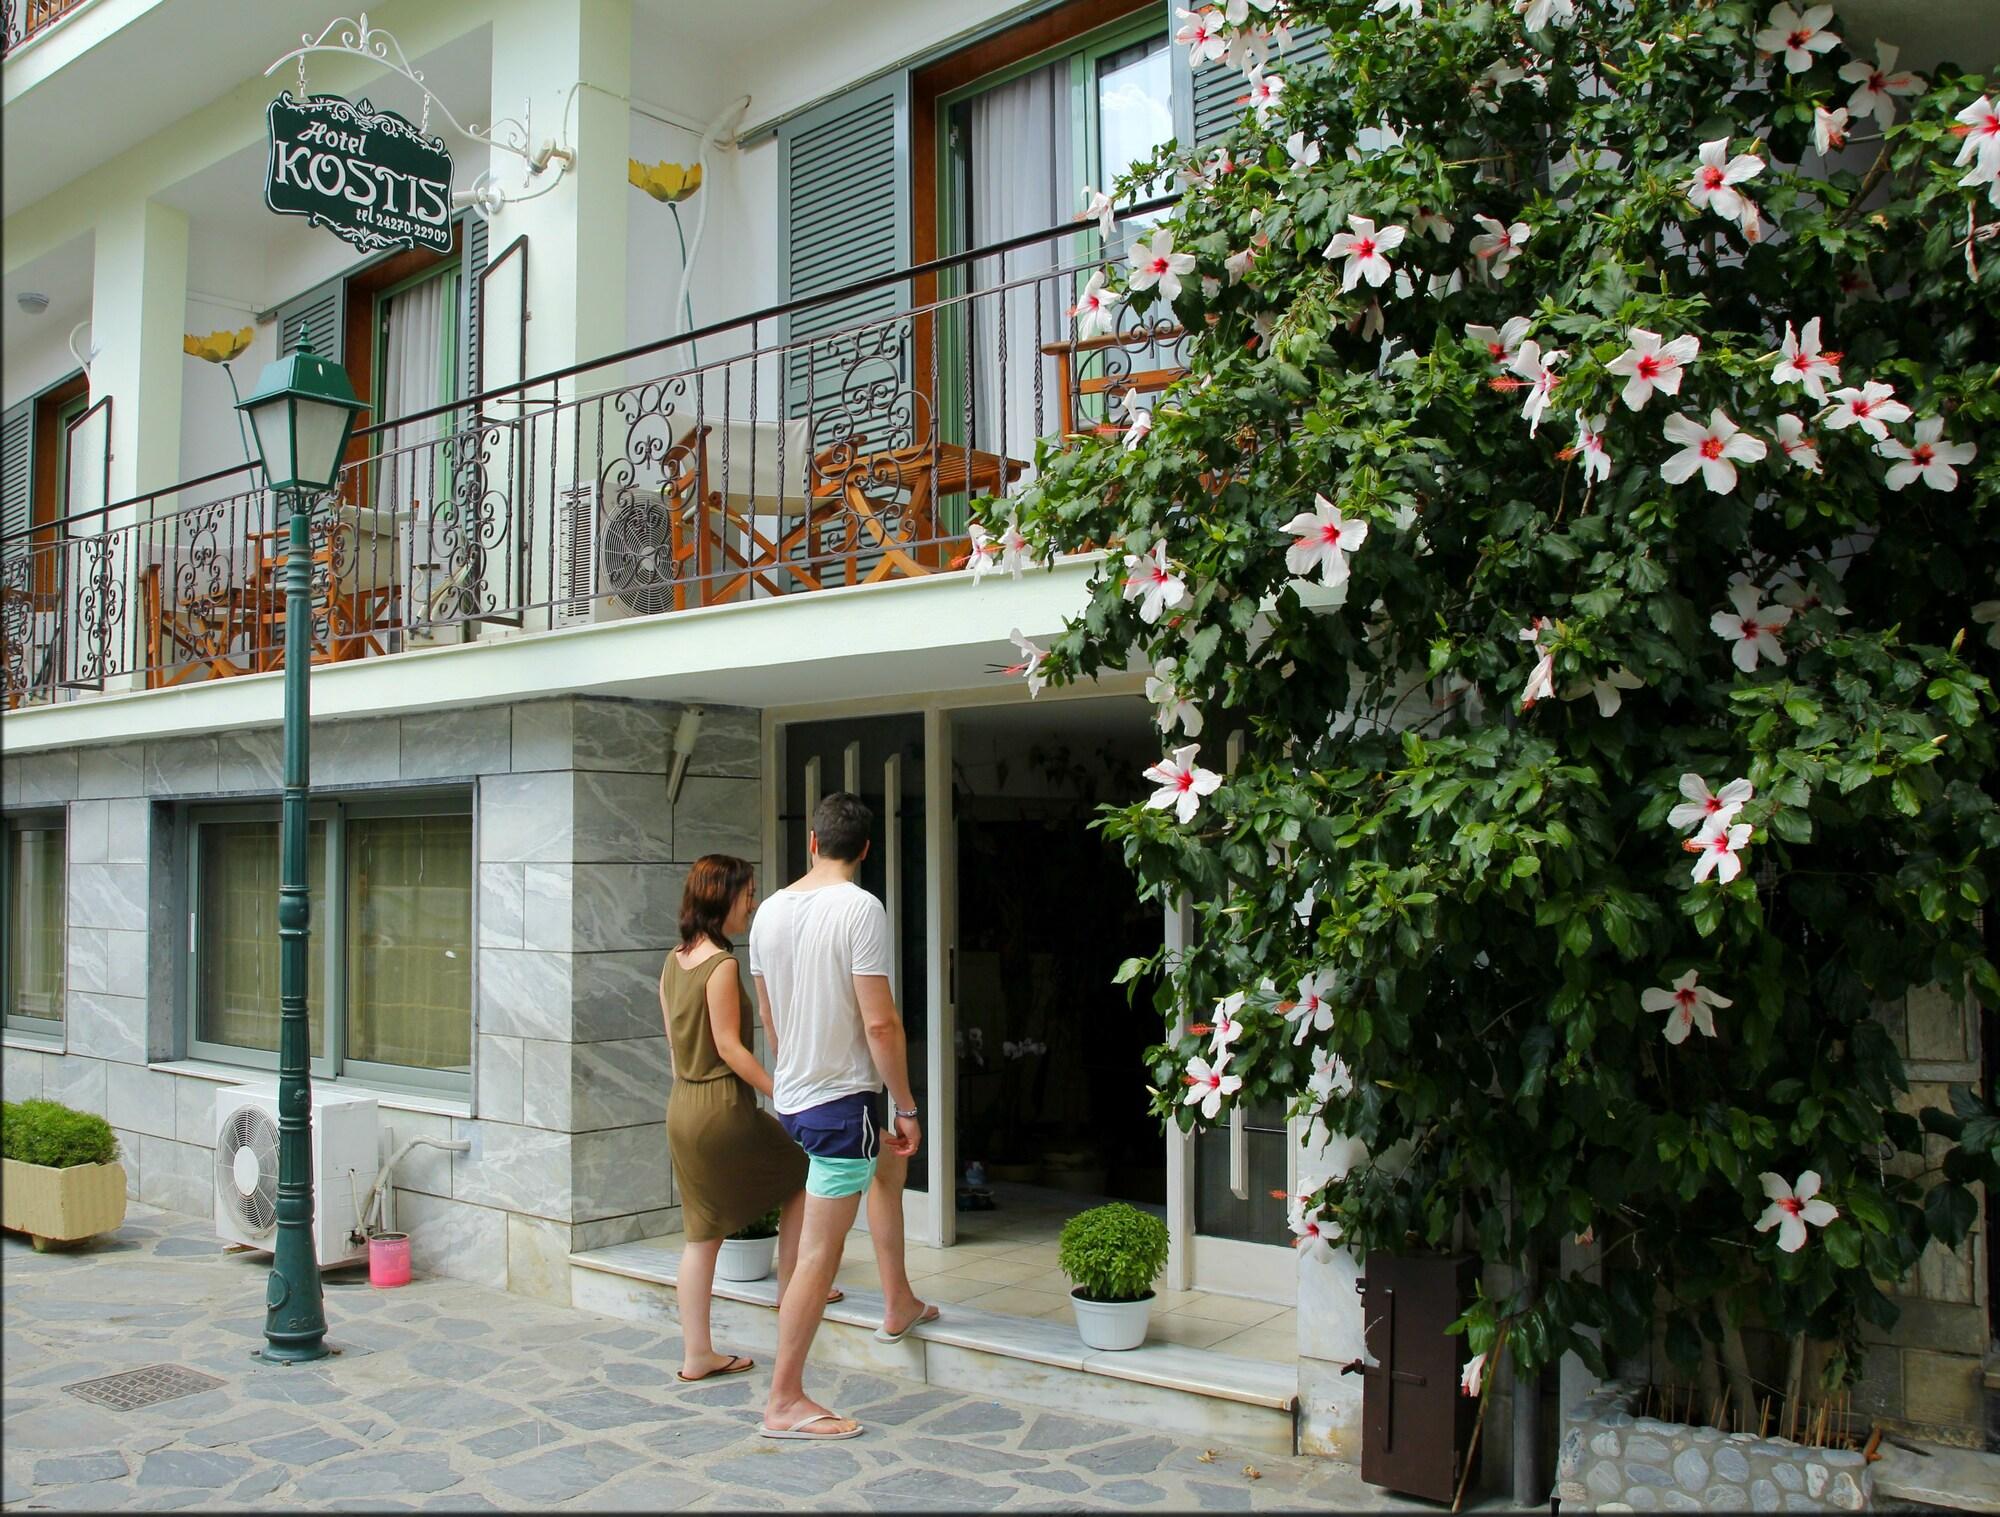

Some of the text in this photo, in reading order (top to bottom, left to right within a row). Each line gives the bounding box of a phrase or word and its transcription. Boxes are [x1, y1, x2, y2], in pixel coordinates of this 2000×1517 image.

[297, 121, 367, 156] Hotel
[275, 140, 448, 225] KOSTIS
[356, 206, 374, 223] tel
